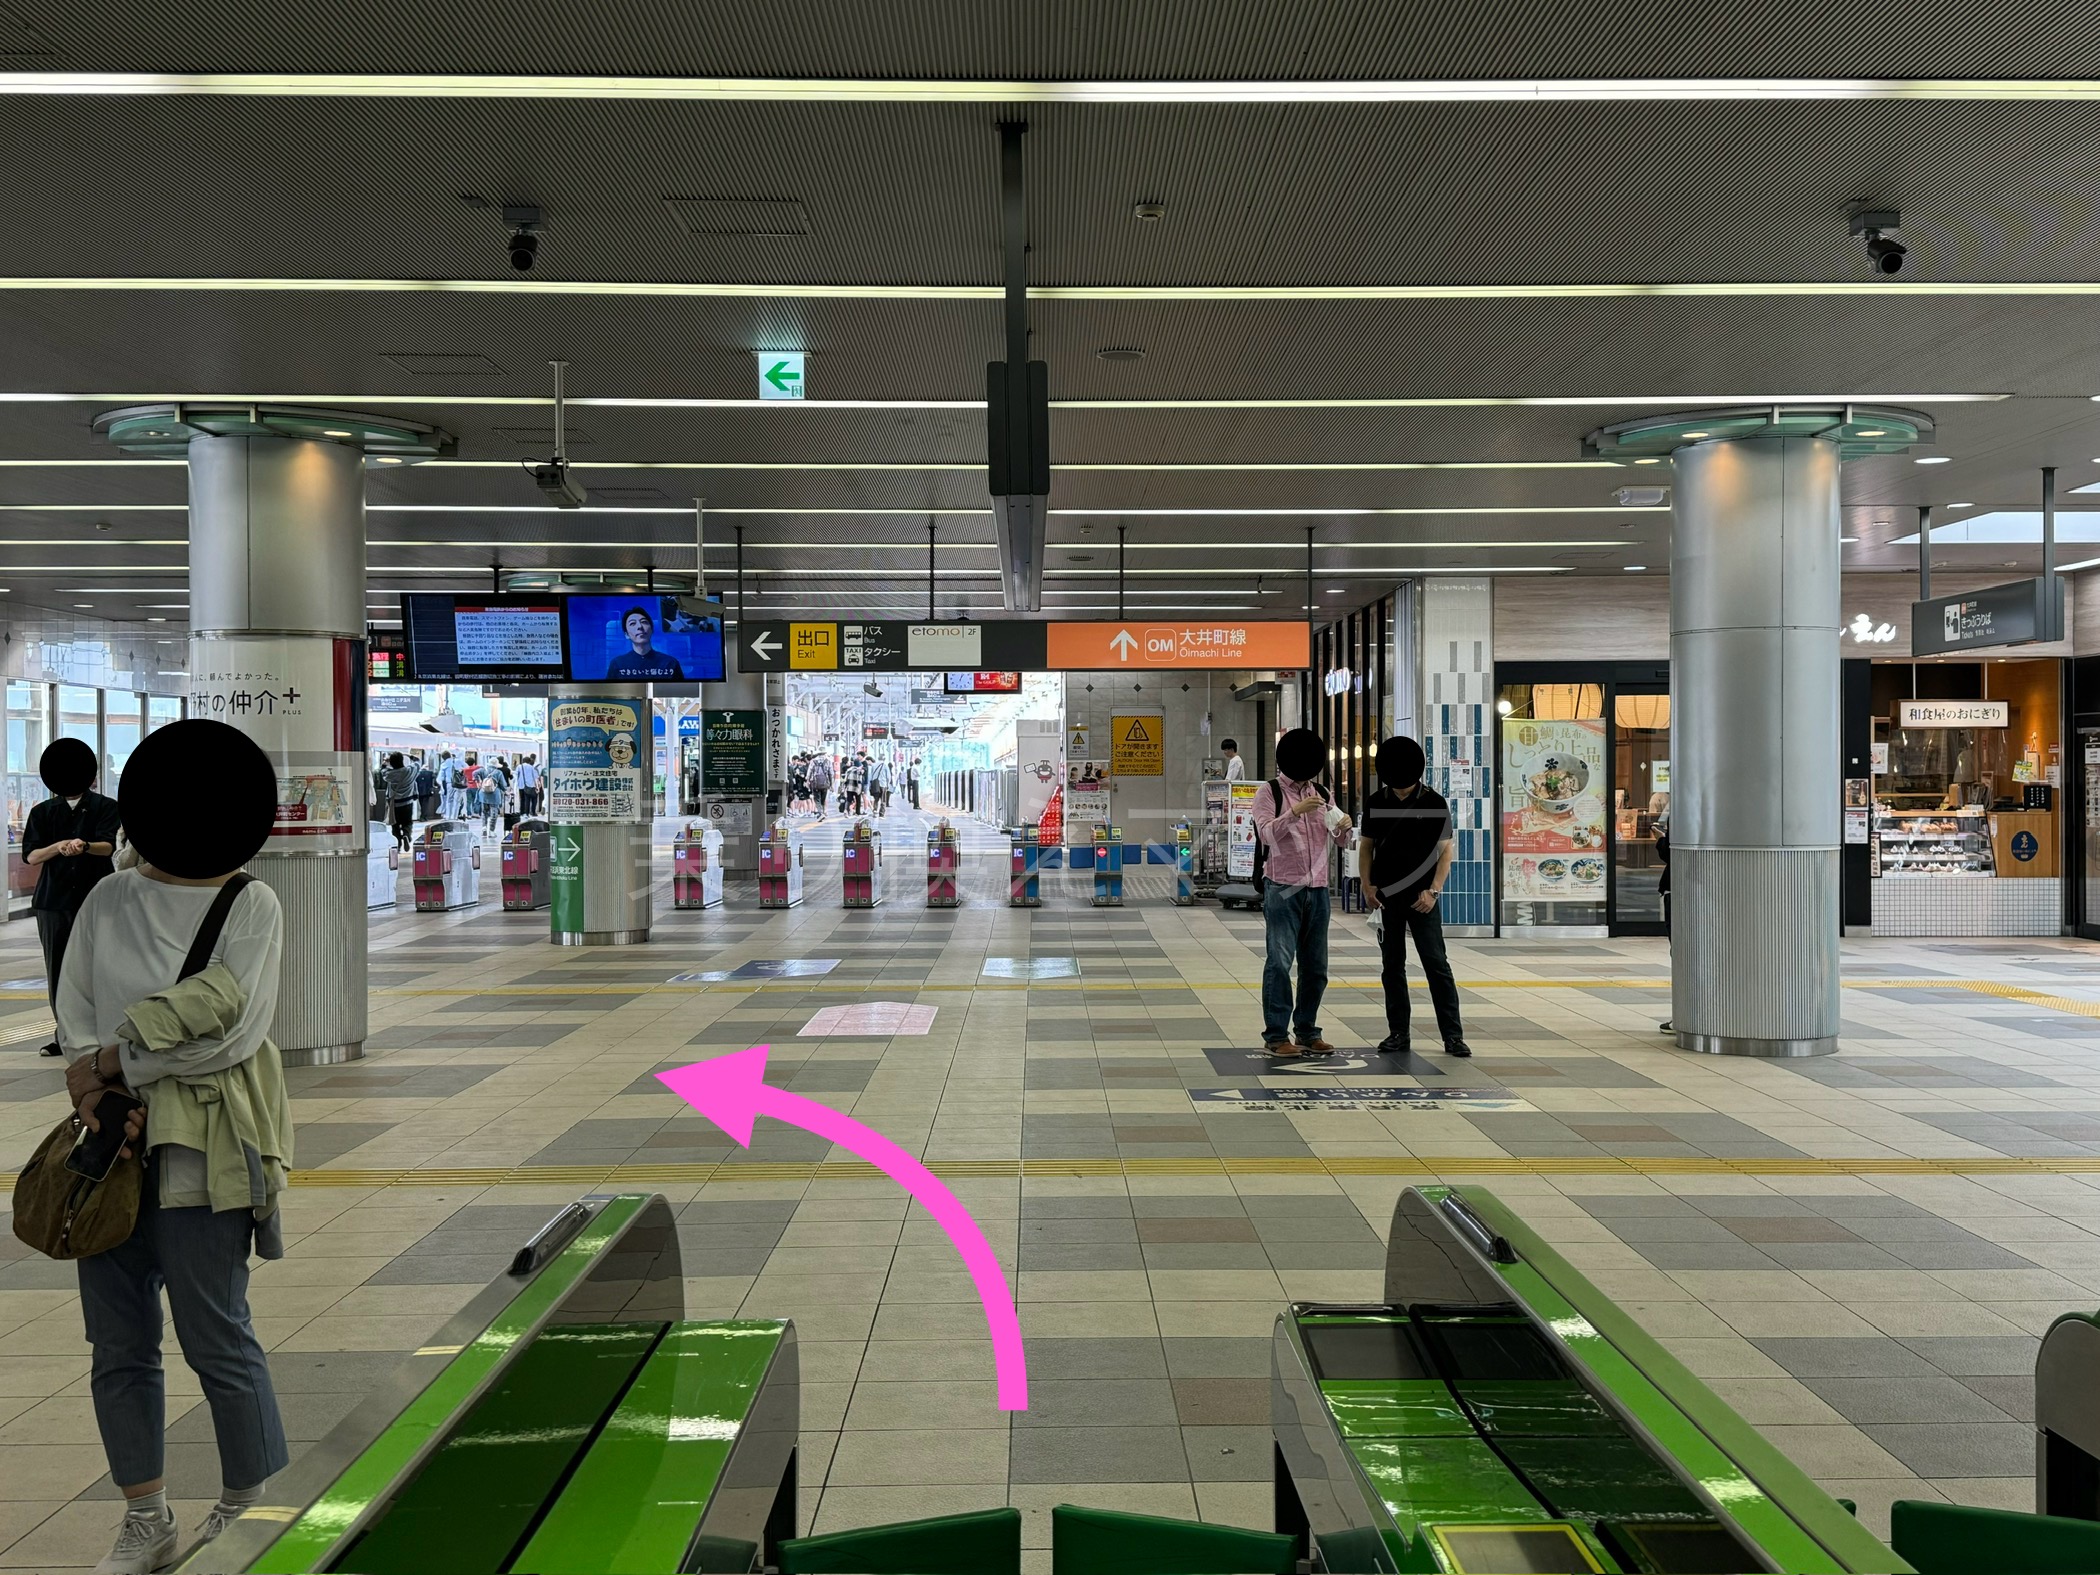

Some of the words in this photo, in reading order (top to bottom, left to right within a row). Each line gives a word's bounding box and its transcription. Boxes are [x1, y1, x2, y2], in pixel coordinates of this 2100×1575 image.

[1961, 612, 1992, 629] きっぷうりば
[864, 625, 883, 636] バス
[911, 627, 960, 636] etomo
[967, 628, 977, 636] 2F
[797, 629, 830, 647] 出口
[1179, 629, 1247, 646] 大井町線
[1147, 639, 1173, 652] OM
[797, 649, 816, 659] Exit
[864, 647, 901, 656] タクシー
[1222, 648, 1242, 658] Line
[619, 668, 674, 676] できないと悩むより
[560, 706, 623, 716] 創業60年、私たちは
[1909, 707, 2001, 721] 和食屋のおにぎり
[706, 728, 753, 741] 等々力眼科
[771, 708, 781, 779] おつかれさまです
[416, 851, 426, 861] IC
[504, 851, 514, 861] IC
[676, 850, 686, 859] IC
[762, 850, 771, 859] IC
[845, 849, 855, 858] IC
[930, 848, 940, 857] IC
[1014, 848, 1023, 857] IC
[1276, 1091, 1469, 1099] りんかい線
